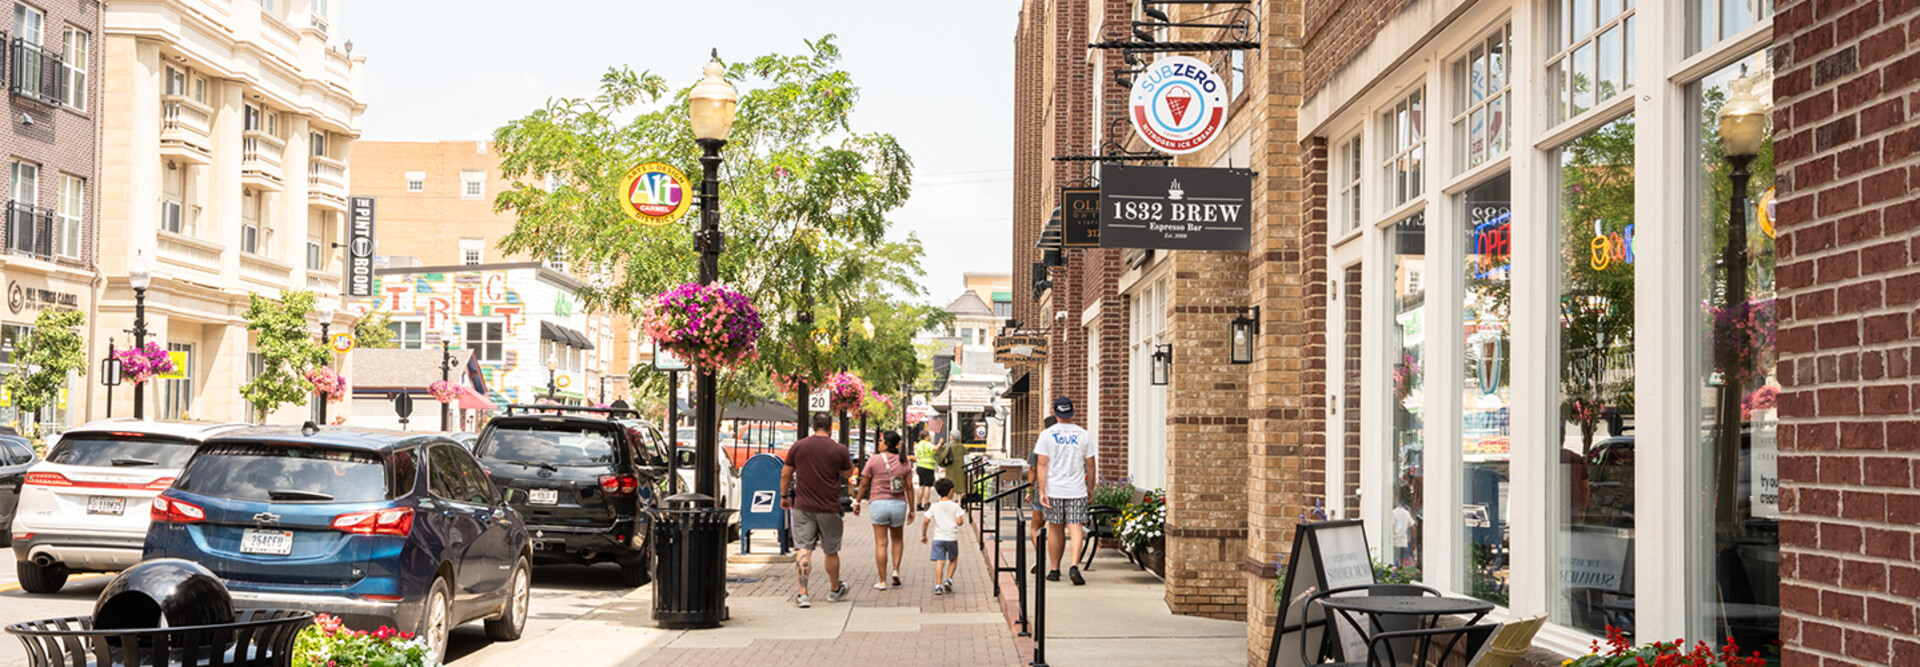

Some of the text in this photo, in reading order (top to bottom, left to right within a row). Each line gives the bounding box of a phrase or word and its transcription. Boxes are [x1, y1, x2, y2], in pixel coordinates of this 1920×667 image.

[1143, 123, 1176, 148] NITROGEN
[1192, 125, 1214, 145] CREAM
[627, 166, 647, 180] ARTS
[656, 165, 685, 183] DESIGN
[631, 174, 681, 206] Art
[635, 212, 675, 224] DISTRICT
[640, 205, 671, 213] CARMEL
[1113, 201, 1241, 222] 1832 BREW
[355, 208, 370, 237] PINT
[1149, 222, 1203, 232] Espresso Bar
[353, 258, 369, 295] ROOM
[811, 397, 825, 408] 20
